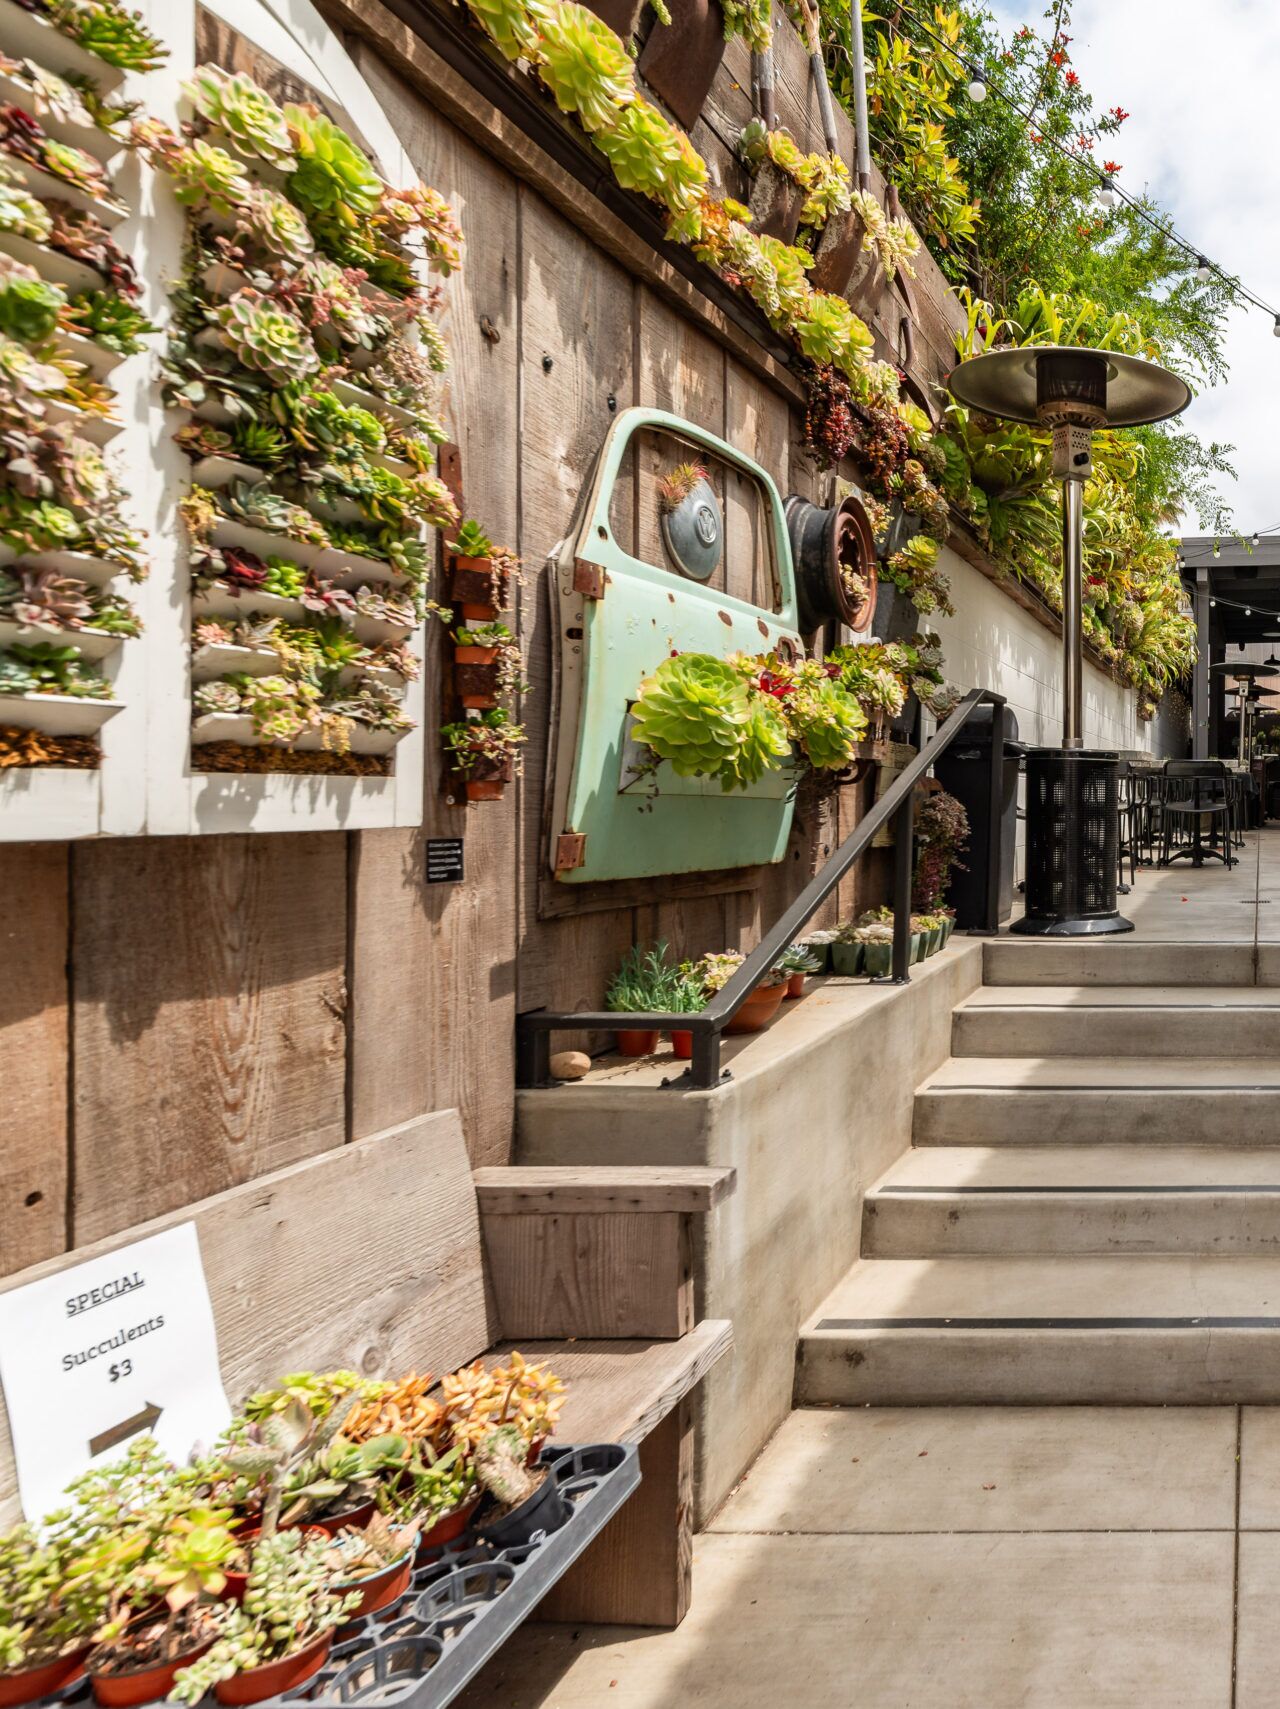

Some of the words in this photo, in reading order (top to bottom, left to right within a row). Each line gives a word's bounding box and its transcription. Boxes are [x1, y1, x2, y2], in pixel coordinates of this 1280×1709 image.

[65, 1271, 145, 1317] SPECIAL
[62, 1314, 165, 1371] Succulents
[108, 1359, 132, 1383] $3
